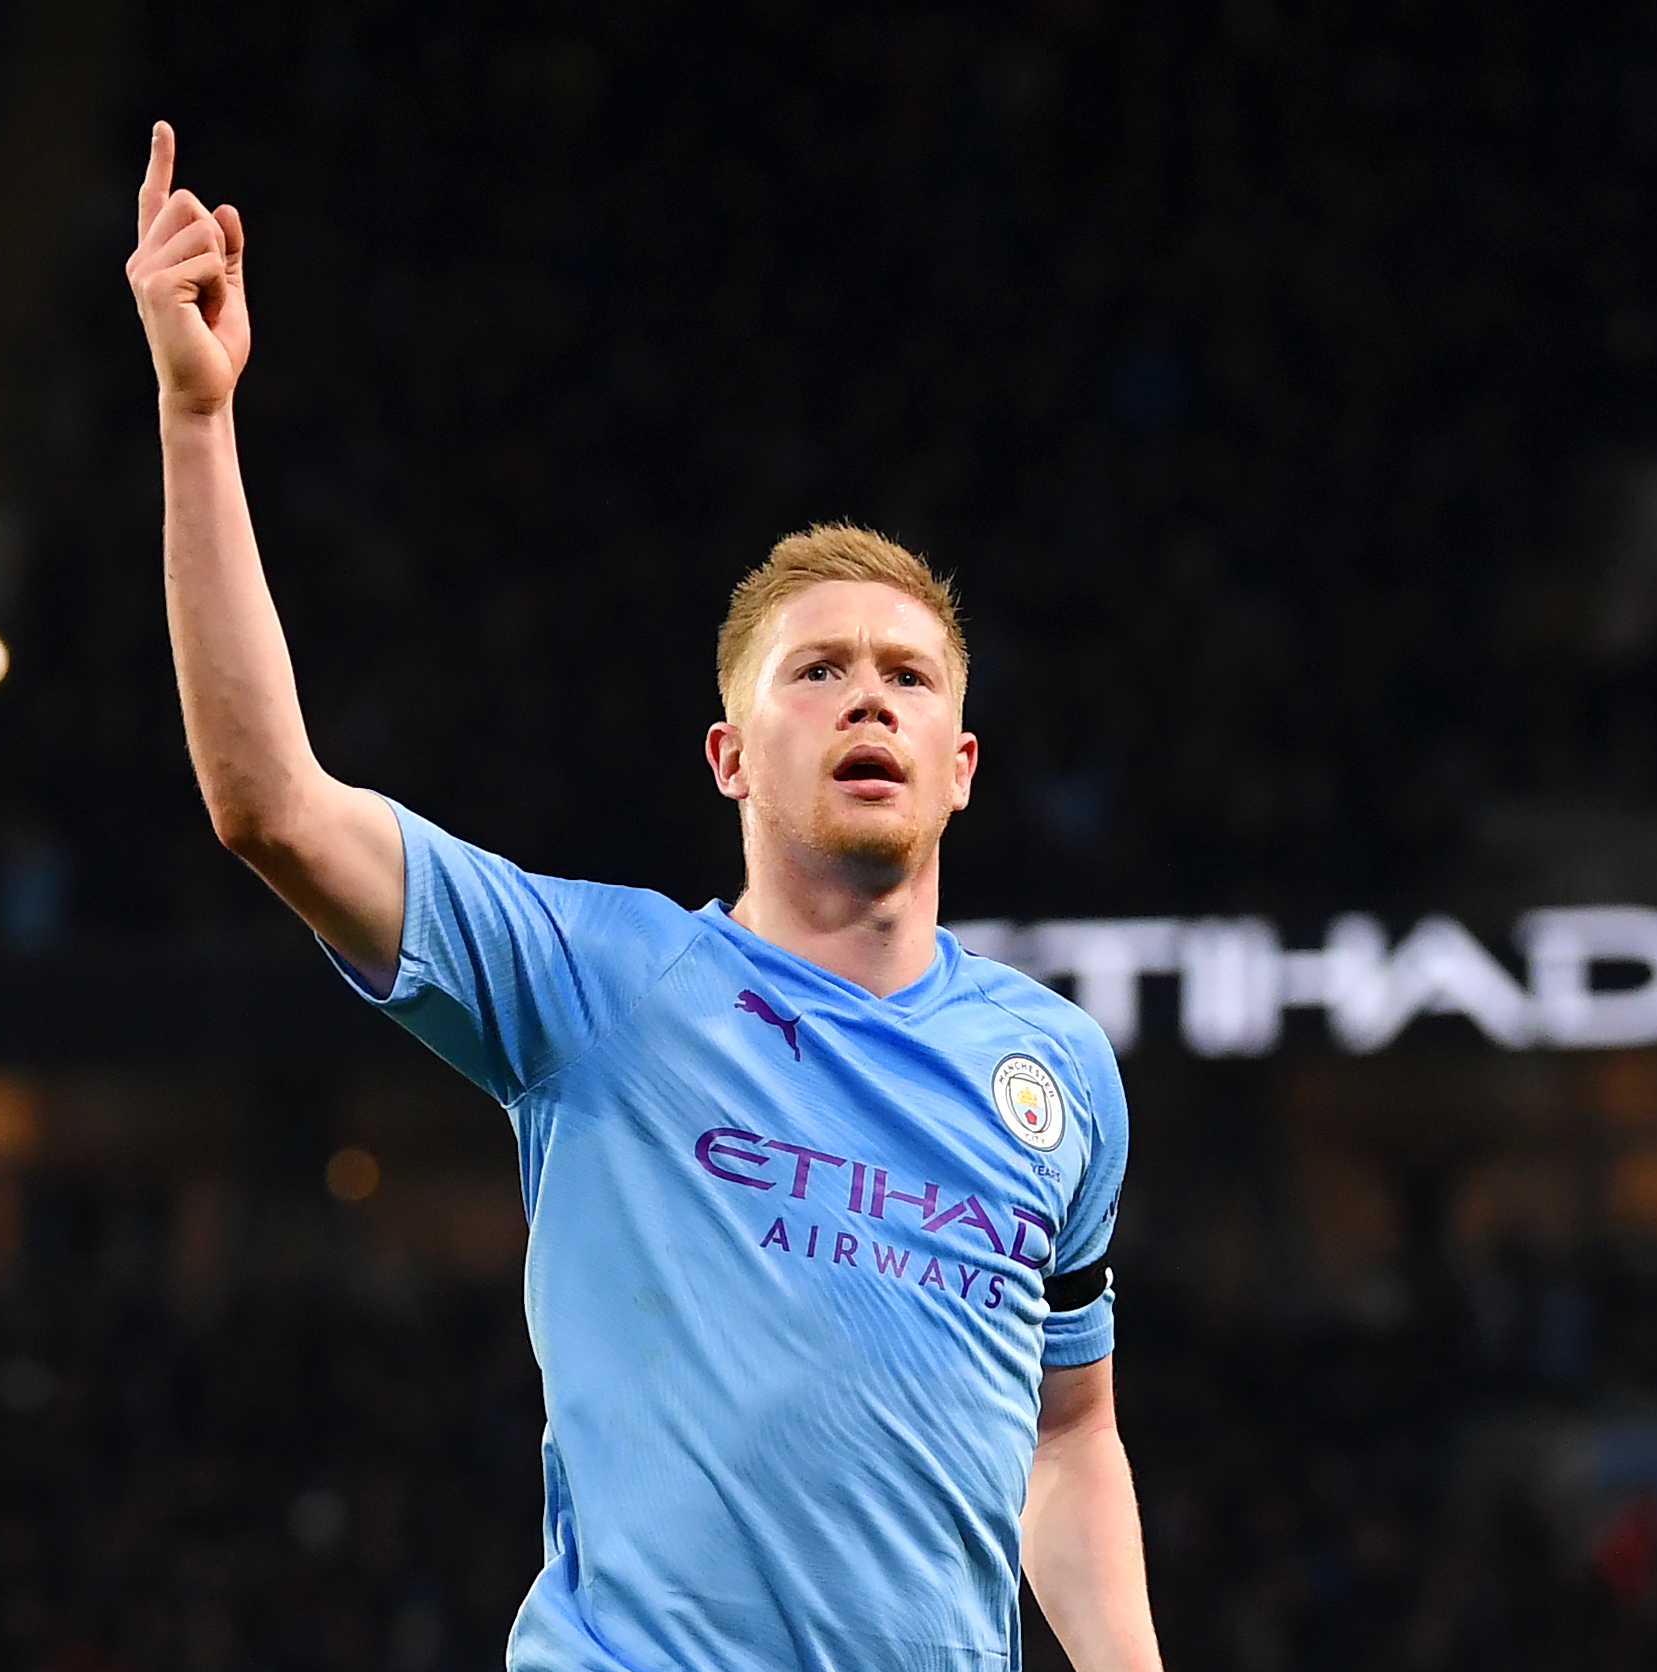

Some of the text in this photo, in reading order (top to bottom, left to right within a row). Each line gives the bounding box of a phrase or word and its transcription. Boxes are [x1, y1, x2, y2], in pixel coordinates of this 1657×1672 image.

[999, 1062, 1055, 1098] MANCHESTER
[1025, 1133, 1045, 1145] CITY
[695, 1127, 1055, 1270] ETIHAD
[760, 1217, 1005, 1309] AIRWAYS
